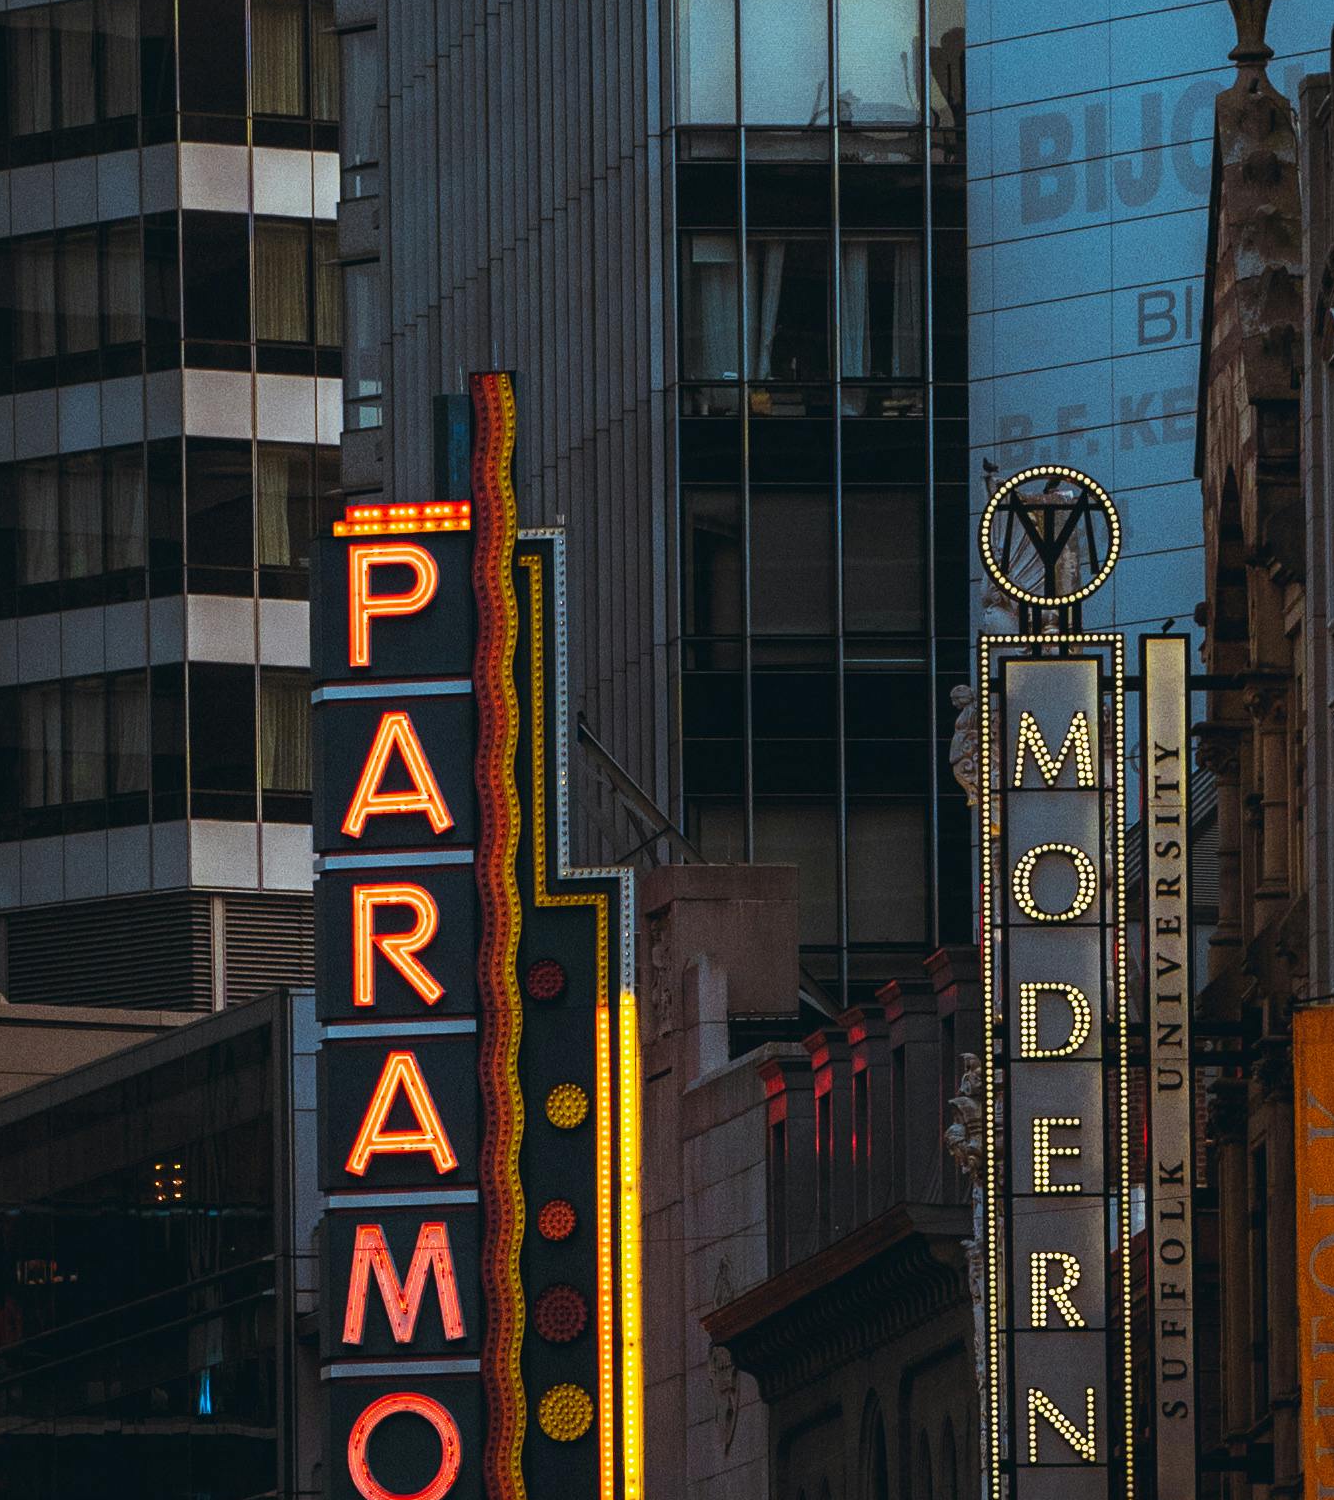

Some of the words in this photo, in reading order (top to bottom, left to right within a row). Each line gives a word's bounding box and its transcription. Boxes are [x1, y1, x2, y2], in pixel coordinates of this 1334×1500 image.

[1012, 710, 1098, 1465] MODERN
[1153, 740, 1185, 1094] UNIVERSITY
[1158, 1158, 1190, 1420] SUFFOLK
